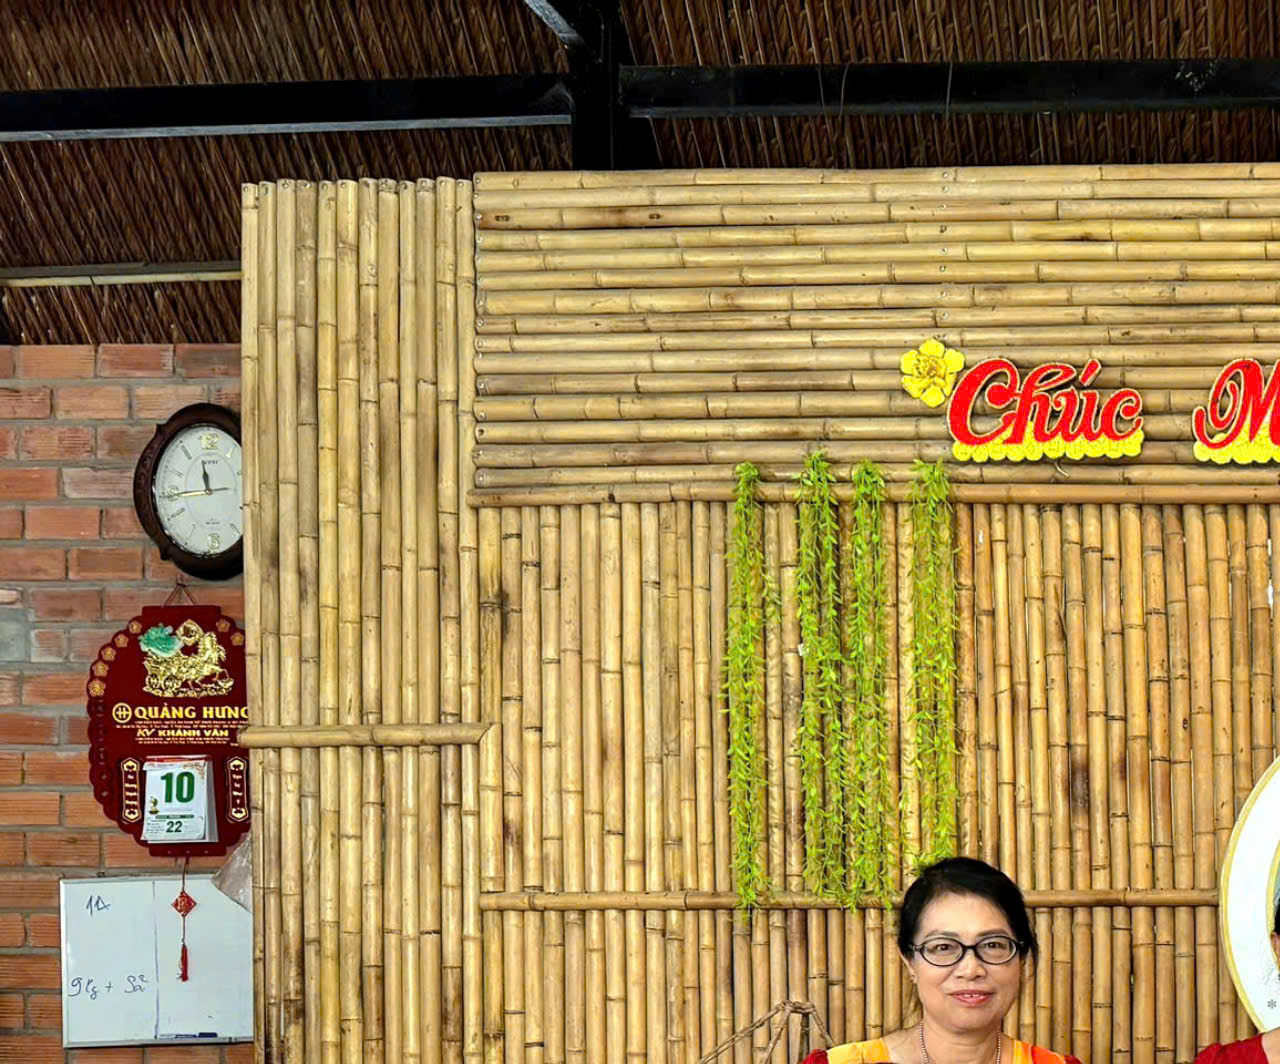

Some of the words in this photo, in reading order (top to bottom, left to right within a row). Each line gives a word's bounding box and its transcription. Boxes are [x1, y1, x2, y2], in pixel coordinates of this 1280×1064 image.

[948, 358, 1141, 446] Chúc
[134, 702, 196, 720] QUẢNG
[160, 771, 195, 803] 10
[166, 820, 182, 833] 22
